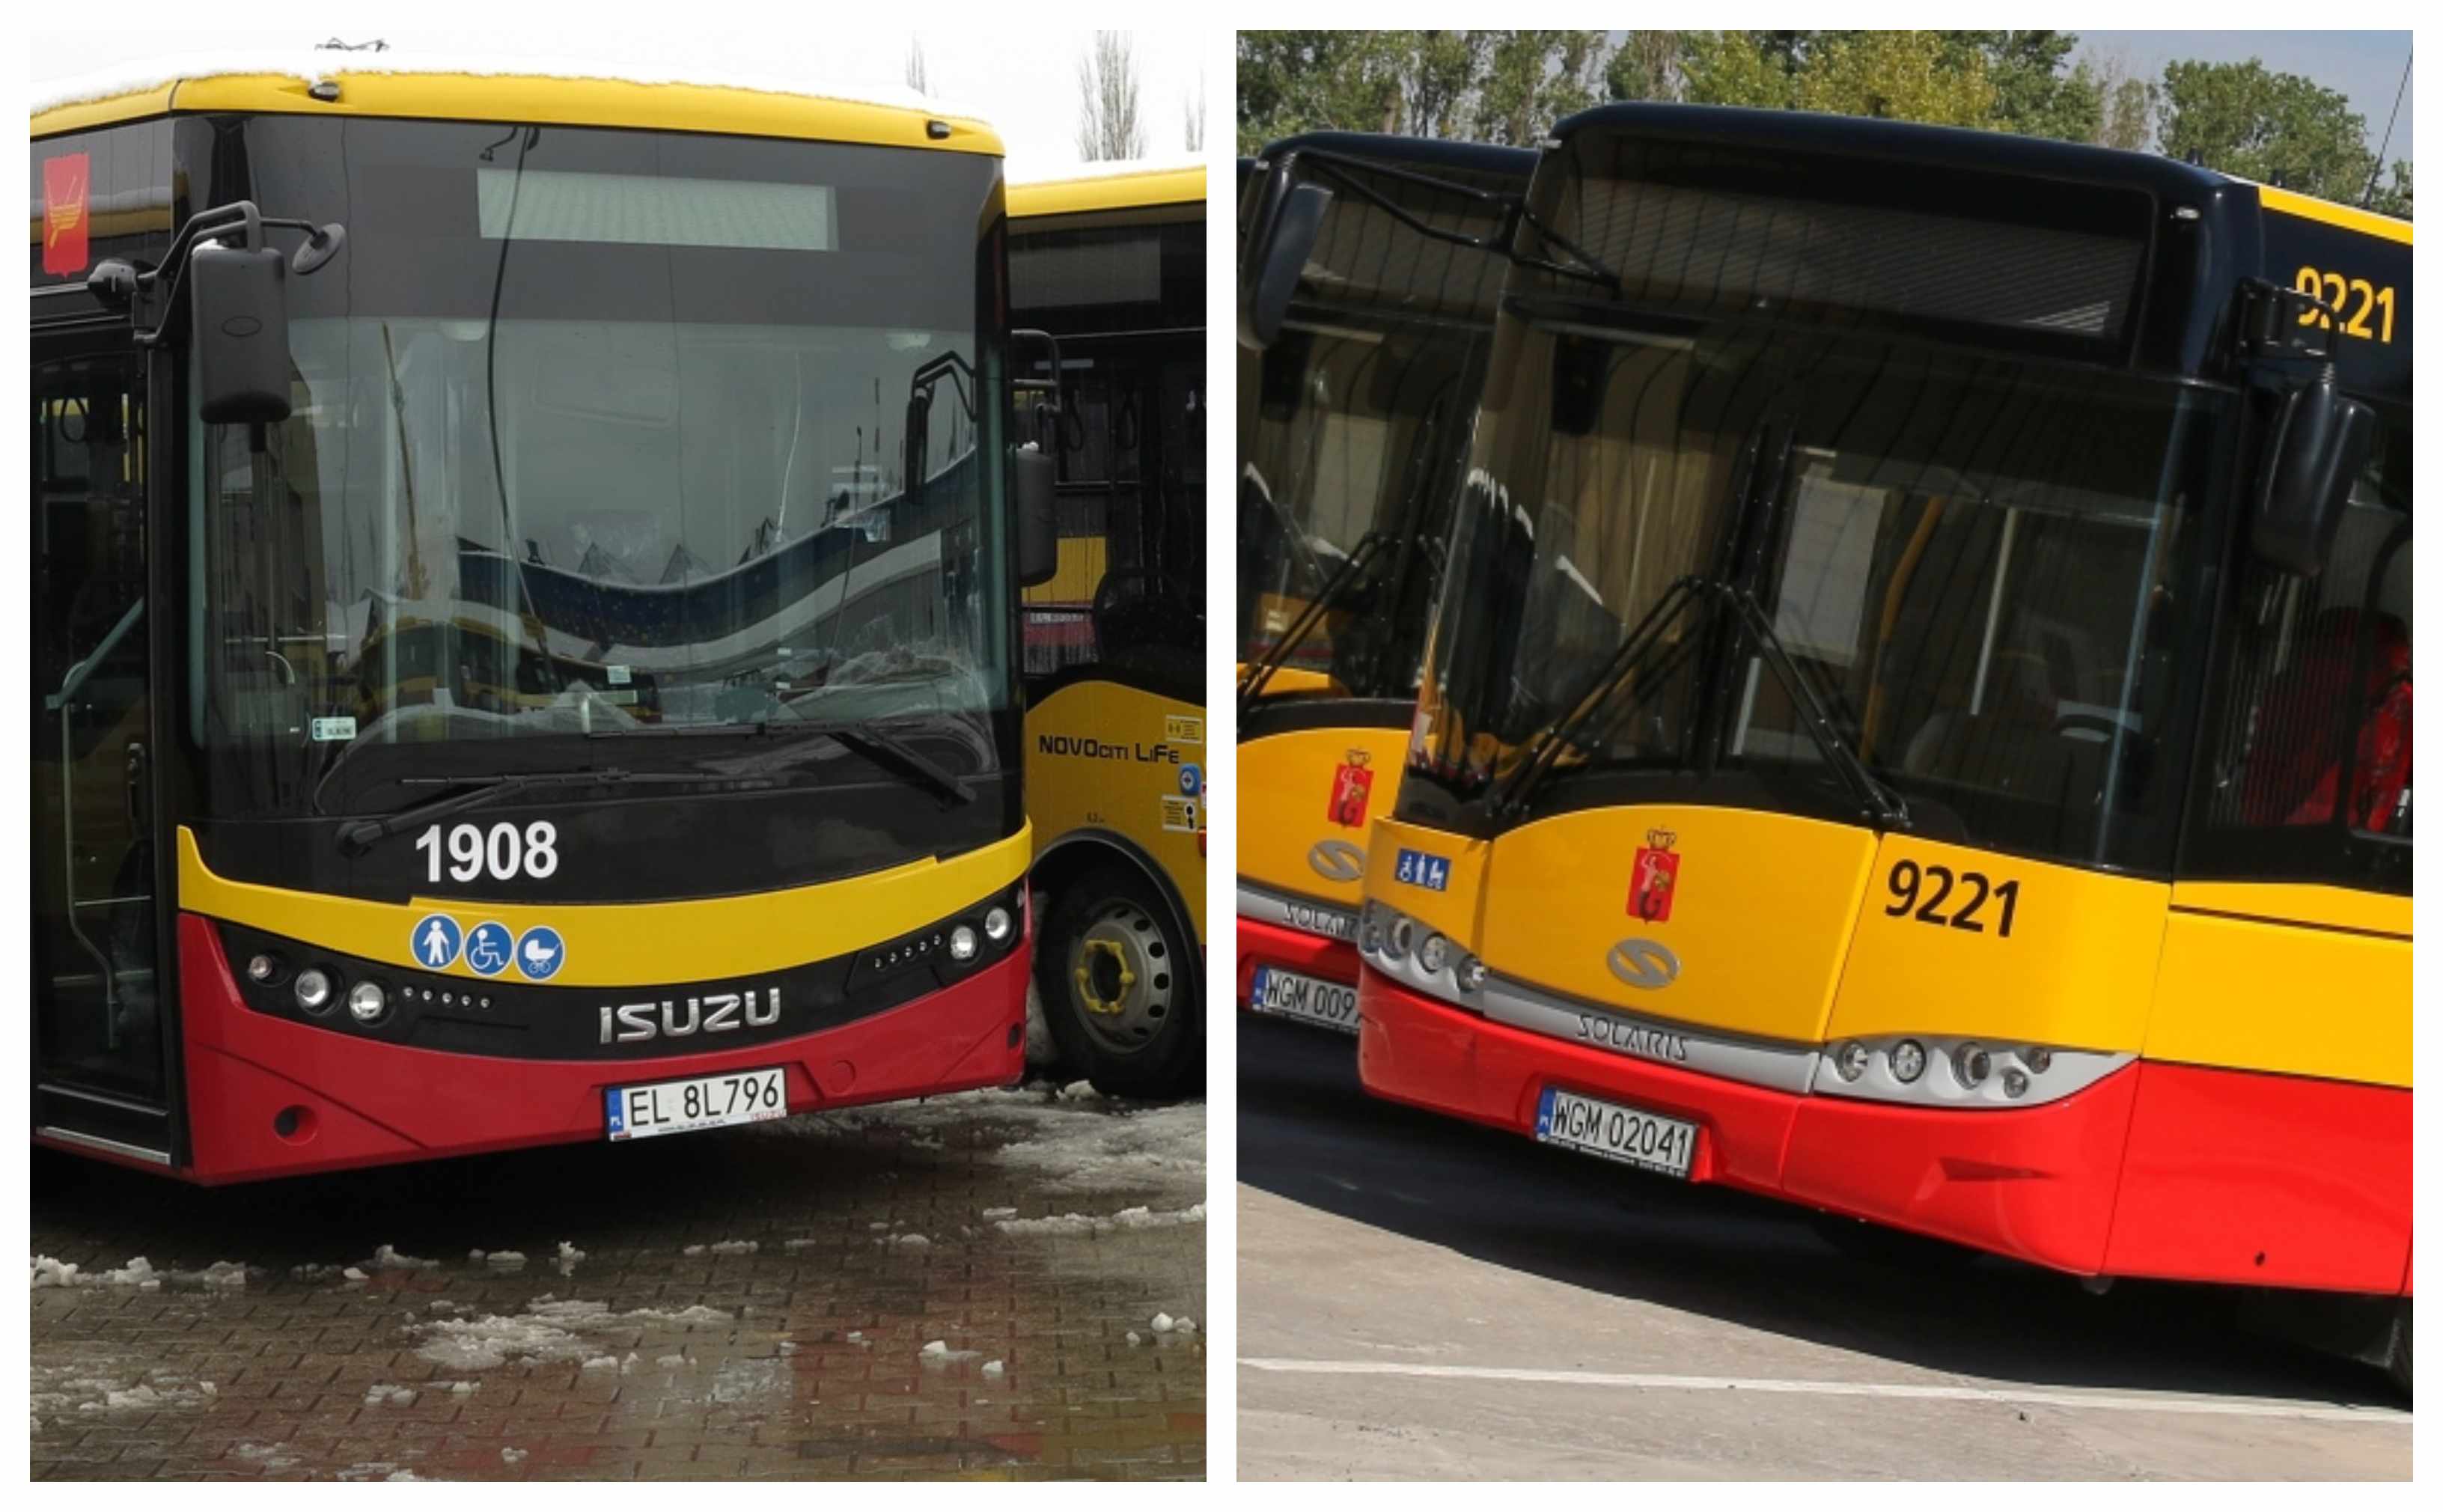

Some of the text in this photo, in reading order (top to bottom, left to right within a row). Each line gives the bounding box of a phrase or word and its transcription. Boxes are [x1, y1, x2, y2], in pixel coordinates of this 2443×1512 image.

[2296, 266, 2394, 343] 9221
[415, 820, 558, 882] 1908
[1885, 859, 2019, 938] 9221
[600, 987, 781, 1044] ISUZU
[1266, 969, 1309, 1010] WGM
[1314, 984, 1360, 1023] 009
[1576, 1012, 1686, 1061] SOLARIS
[629, 1073, 779, 1126] EL 8L796
[1553, 1098, 1602, 1144] WGM
[1610, 1111, 1688, 1164] 02041
